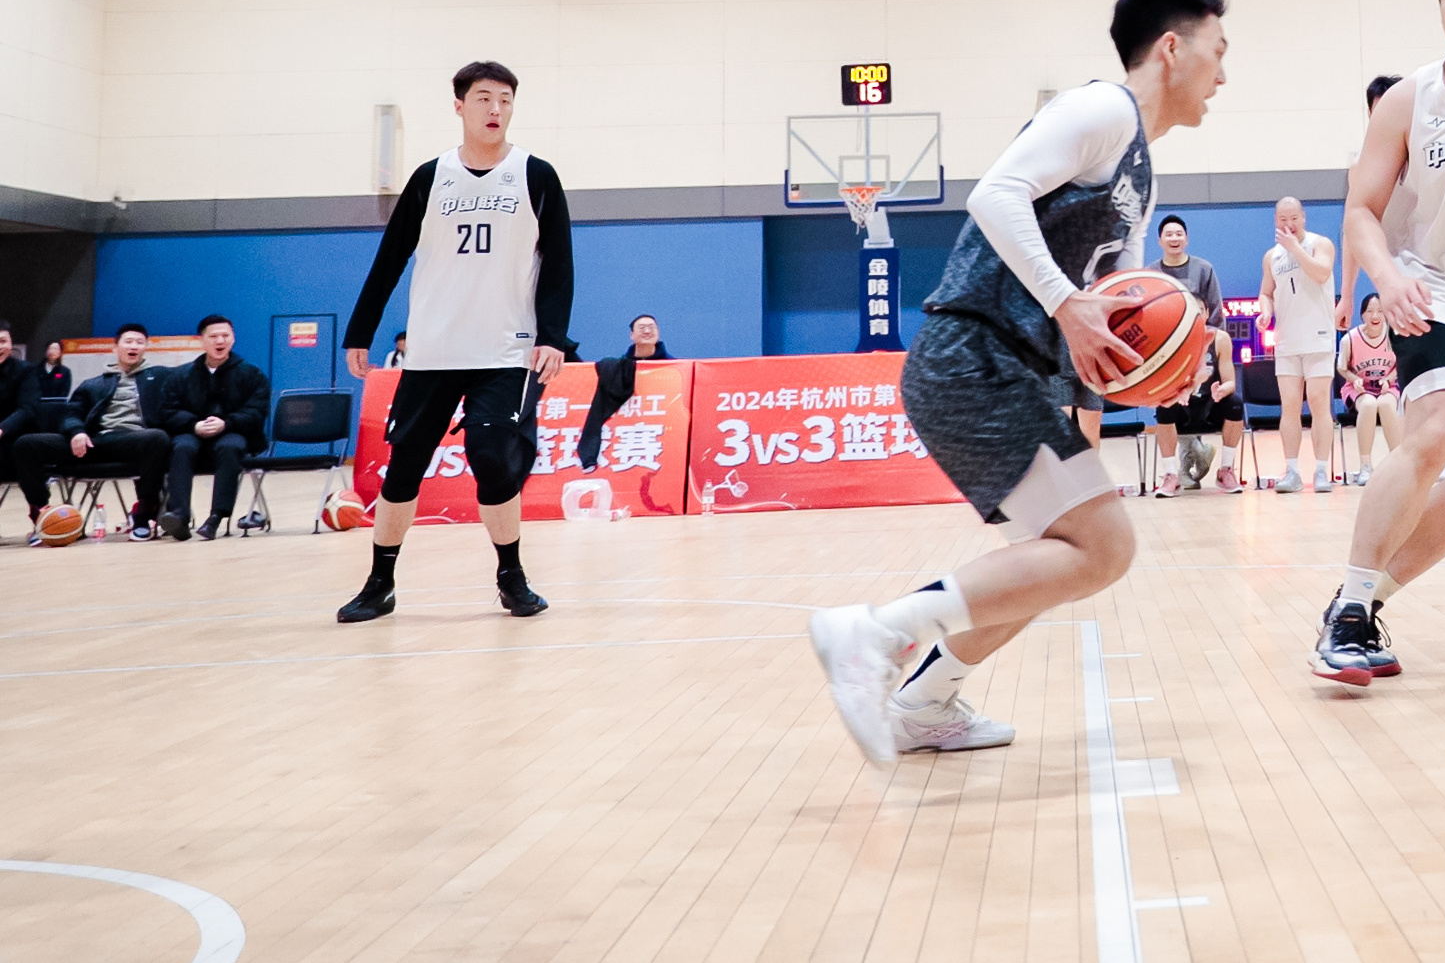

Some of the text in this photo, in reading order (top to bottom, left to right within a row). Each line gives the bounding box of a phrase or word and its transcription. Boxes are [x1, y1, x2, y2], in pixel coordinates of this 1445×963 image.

[850, 65, 888, 83] 10:00
[859, 82, 882, 103] 16
[440, 195, 519, 216] 中国联合
[457, 223, 491, 254] 20
[1290, 277, 1296, 295] 1
[867, 258, 889, 336] 金陵体育
[716, 383, 903, 412] 2024年杭州市第
